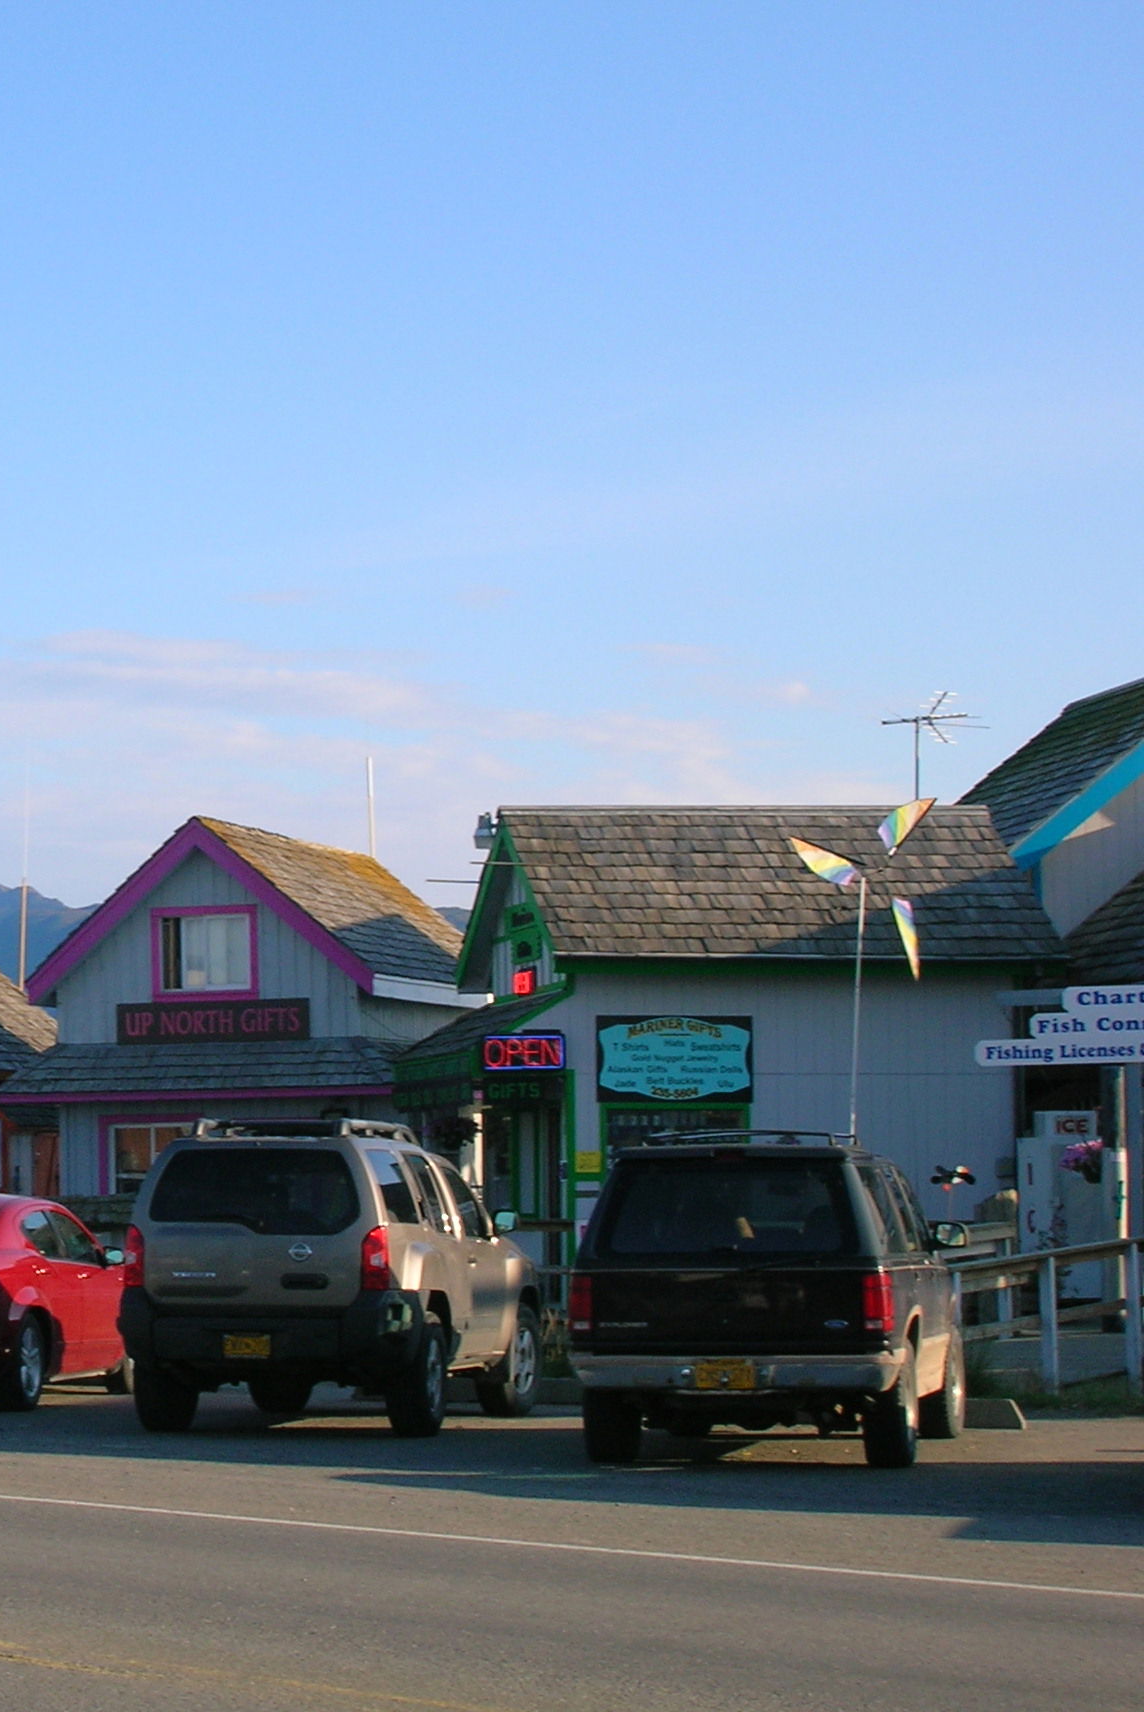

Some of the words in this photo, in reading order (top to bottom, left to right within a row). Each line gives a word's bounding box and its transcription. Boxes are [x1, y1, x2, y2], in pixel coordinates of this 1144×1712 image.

[125, 1012, 153, 1036] UP
[160, 1010, 234, 1035] NORTH
[240, 1008, 300, 1033] GIFTS
[627, 1018, 684, 1039] MARINER
[686, 1020, 723, 1039] GIFTS
[1037, 1018, 1086, 1033] Fish
[484, 1039, 561, 1067] OPEN
[612, 1042, 618, 1051] T
[621, 1042, 649, 1051] Shirts
[690, 1042, 742, 1052] Sweatshirts
[985, 1045, 1054, 1063] Fishing
[1060, 1044, 1135, 1058] Licenses
[630, 1054, 651, 1062] Gold
[654, 1054, 684, 1064] Nugget
[686, 1054, 718, 1063] Jewelry
[608, 1065, 643, 1073] Alaskan
[646, 1065, 668, 1073] Gifts
[680, 1065, 718, 1073] Russian
[719, 1065, 743, 1073] Dolls
[614, 1080, 636, 1088] Jade
[667, 1077, 705, 1085] Buckles
[488, 1082, 541, 1098] GIFTS
[1057, 1119, 1088, 1134] ICE
